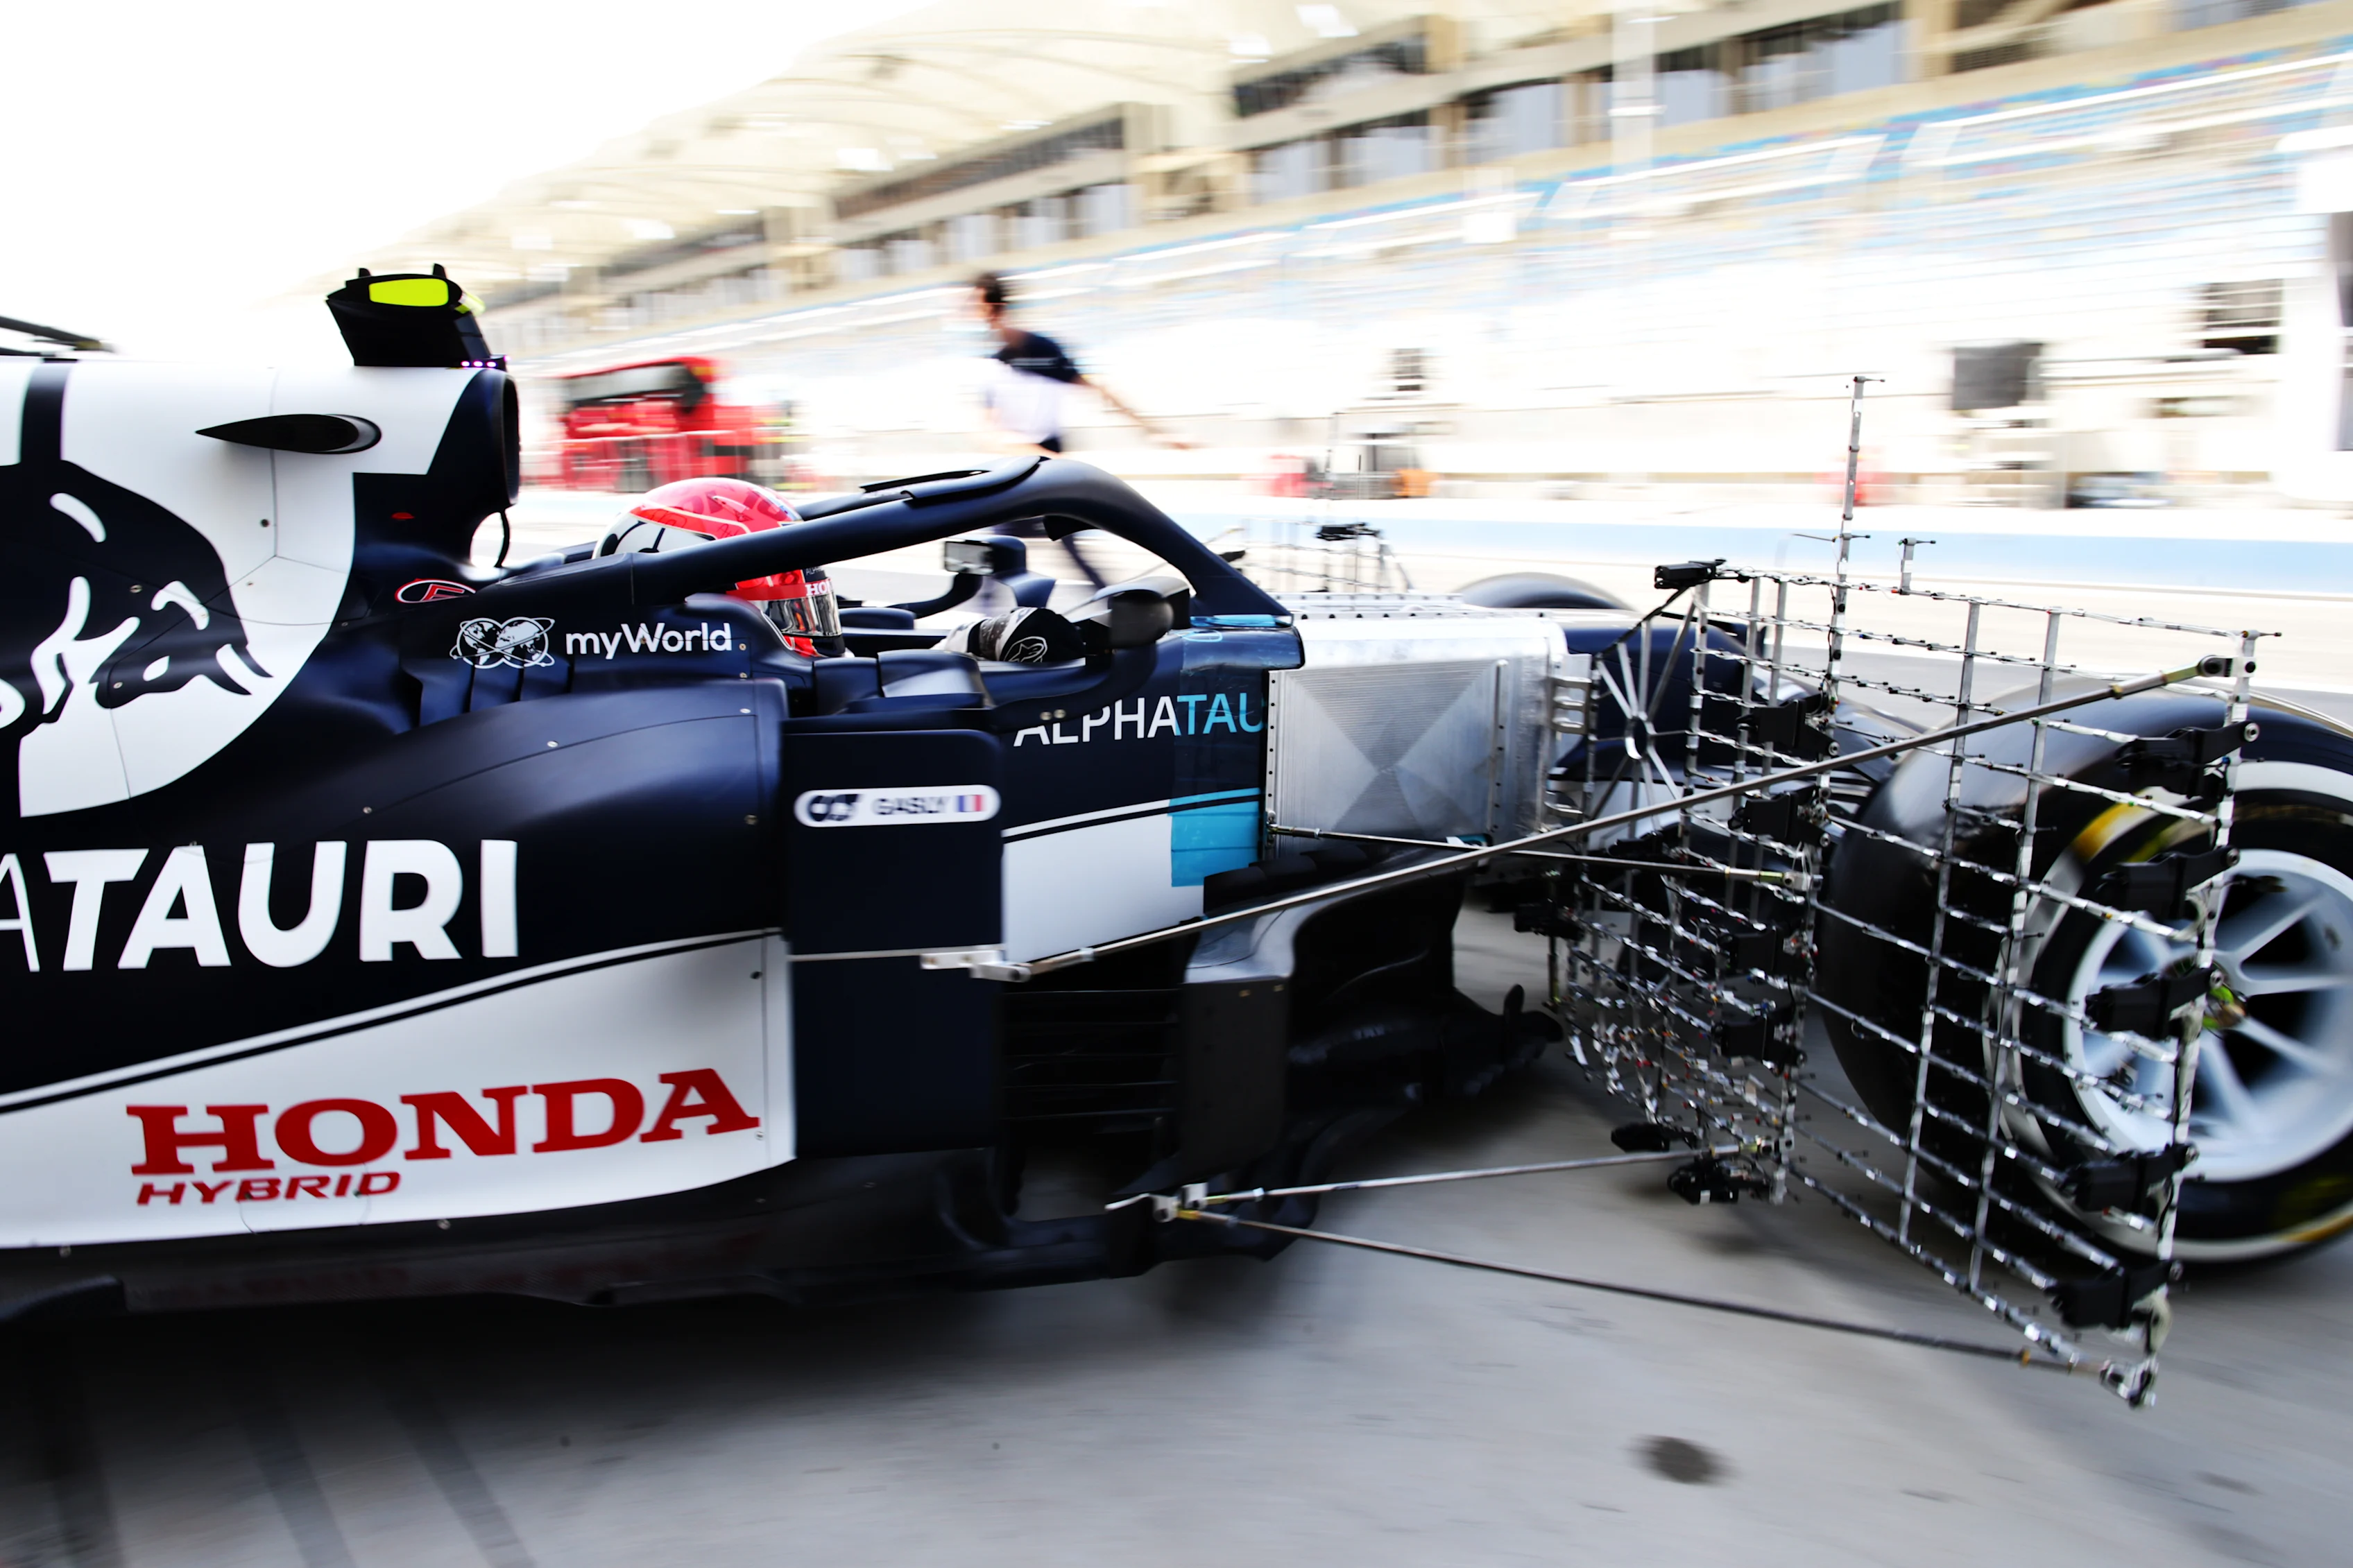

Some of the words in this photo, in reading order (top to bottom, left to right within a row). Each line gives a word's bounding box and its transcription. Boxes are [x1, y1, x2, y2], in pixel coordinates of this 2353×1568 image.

[565, 622, 732, 660] myWorld
[126, 1068, 760, 1175] HONDA
[137, 1172, 401, 1206] HYBRID
